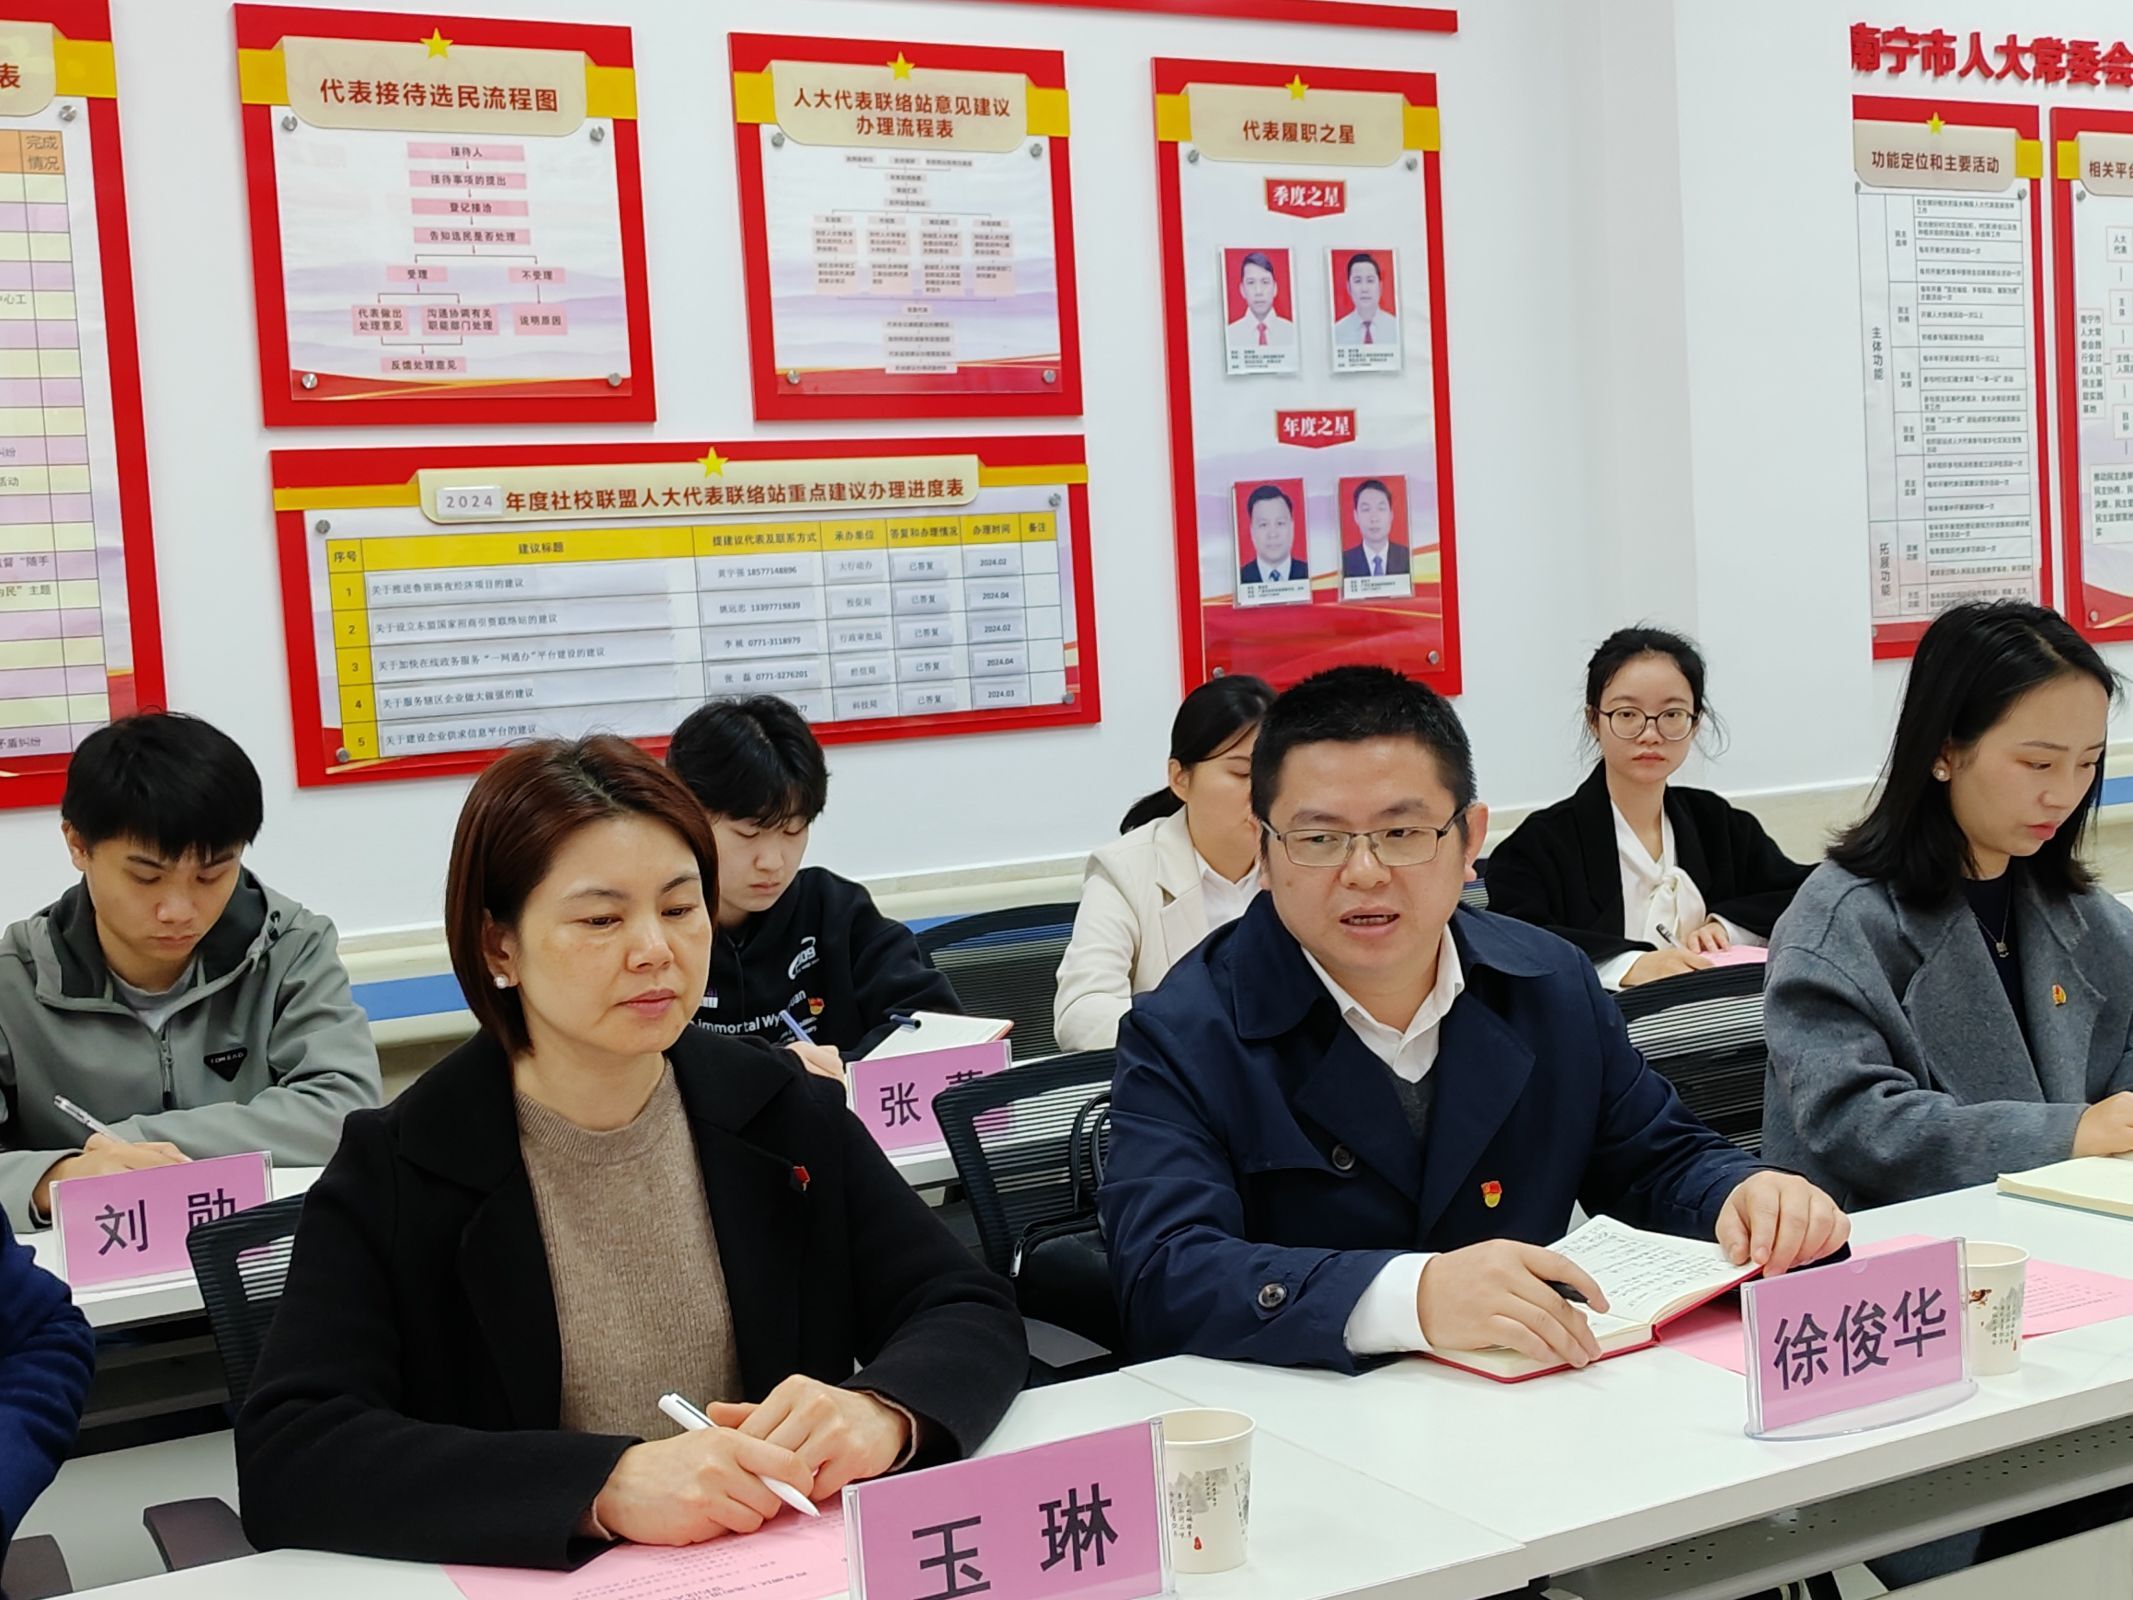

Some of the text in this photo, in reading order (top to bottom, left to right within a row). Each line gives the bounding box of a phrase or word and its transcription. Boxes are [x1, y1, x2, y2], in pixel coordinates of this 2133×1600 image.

[320, 78, 558, 113] 代表接待选民流程图
[794, 87, 1011, 118] 人大代表联络站意见建议
[856, 115, 954, 139] 办理流程表
[1243, 119, 1355, 144] 代表履职之星
[26, 135, 58, 150] 完成
[451, 146, 482, 157] 接待人
[1871, 150, 2000, 175] 功能定位和主要活动
[431, 174, 506, 186] 接待事项的提出
[1273, 184, 1340, 208] 季度之星
[430, 230, 515, 242] 告知选民是否处理
[407, 269, 428, 280] 受理
[521, 269, 553, 281] 不受理
[358, 308, 402, 318] 代表做出
[427, 308, 491, 319] 沟通协调有关
[359, 320, 403, 331] 处理意见
[428, 320, 493, 331] 职能部门处理
[520, 315, 561, 327] 说明原因
[391, 359, 457, 370] 反馈处理意见
[1283, 416, 1351, 438] 年度之星
[446, 478, 964, 513] 2024 年度社校联盟人大代表联络站重点建议办理进度表
[890, 525, 958, 540] 答复和办理情况
[972, 523, 1011, 536] 办理时间
[1028, 522, 1047, 533] 备注
[712, 530, 817, 548] 提建议代表及联系方式
[834, 528, 875, 542] 承办单位
[518, 540, 564, 556] 建议标题
[334, 549, 357, 564] 序号
[909, 561, 933, 571] 已答复
[346, 587, 352, 598] 1
[912, 594, 936, 605] 已答复
[348, 624, 355, 635] 2
[915, 628, 939, 638] 已答复
[351, 661, 359, 672] 3
[916, 661, 940, 672] 已答复
[355, 699, 362, 710] 4
[918, 694, 942, 705] 已答复
[357, 736, 365, 747] 5
[1773, 1285, 1947, 1391] 徐俊华
[912, 1482, 1119, 1600] 玉琳
